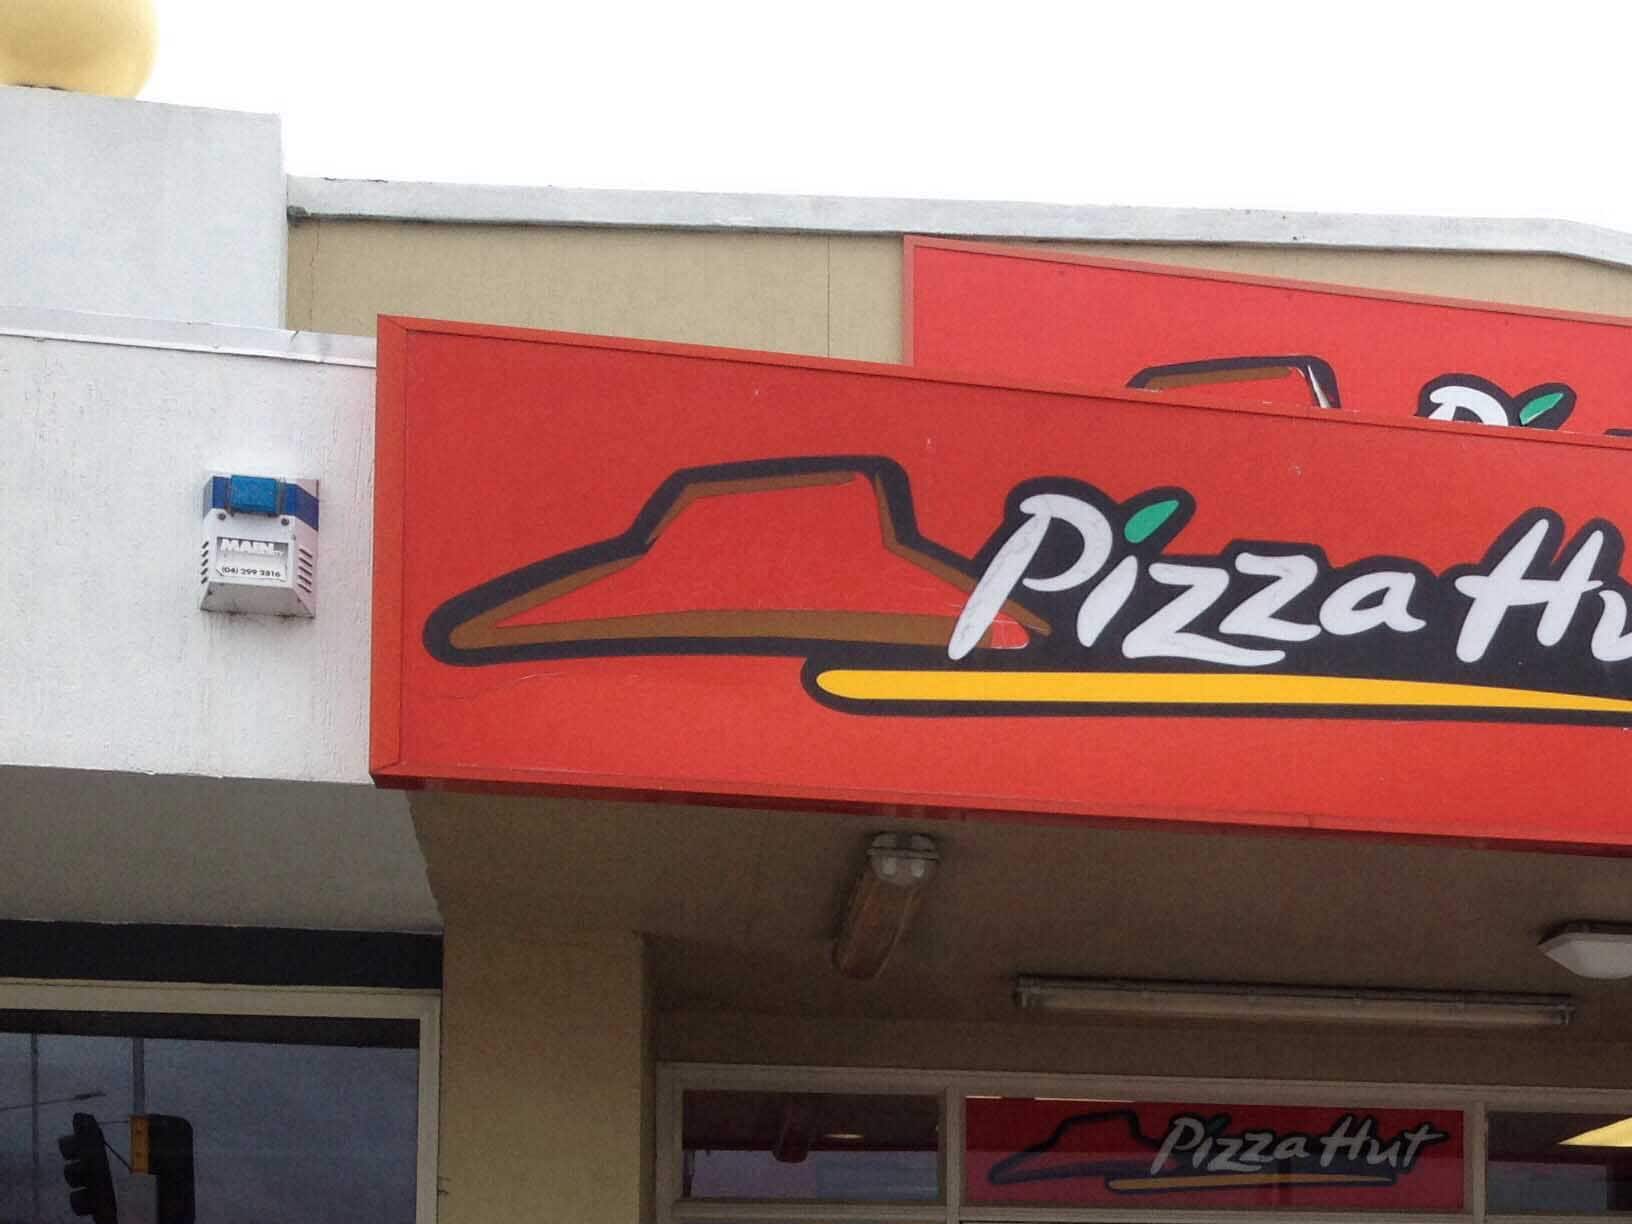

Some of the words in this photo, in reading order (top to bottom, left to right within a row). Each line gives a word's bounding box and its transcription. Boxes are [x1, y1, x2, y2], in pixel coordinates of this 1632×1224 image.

[220, 538, 275, 555] MAIN
[947, 492, 1426, 666] Pizza
[1150, 1115, 1310, 1176] Pizza
[1319, 1114, 1447, 1169] Hut
